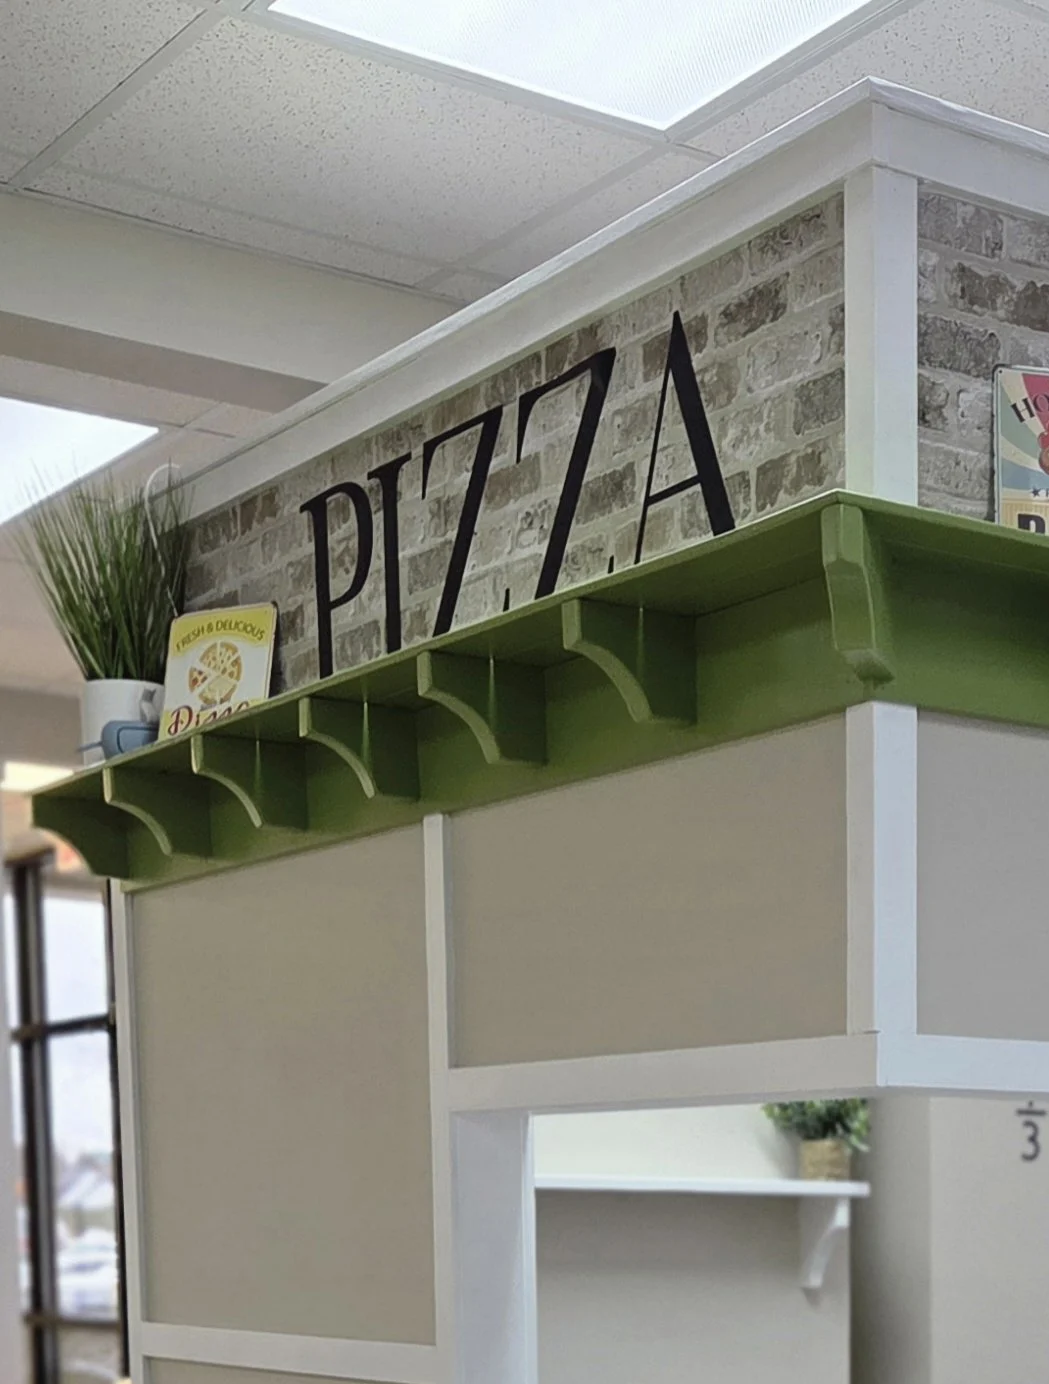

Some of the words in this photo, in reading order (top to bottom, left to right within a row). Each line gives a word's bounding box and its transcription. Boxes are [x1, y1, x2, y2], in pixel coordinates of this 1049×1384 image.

[300, 310, 735, 679] PIZZA
[176, 625, 205, 652] FRESH
[216, 619, 265, 641] DELICIOUS
[1021, 1120, 1041, 1163] 3
